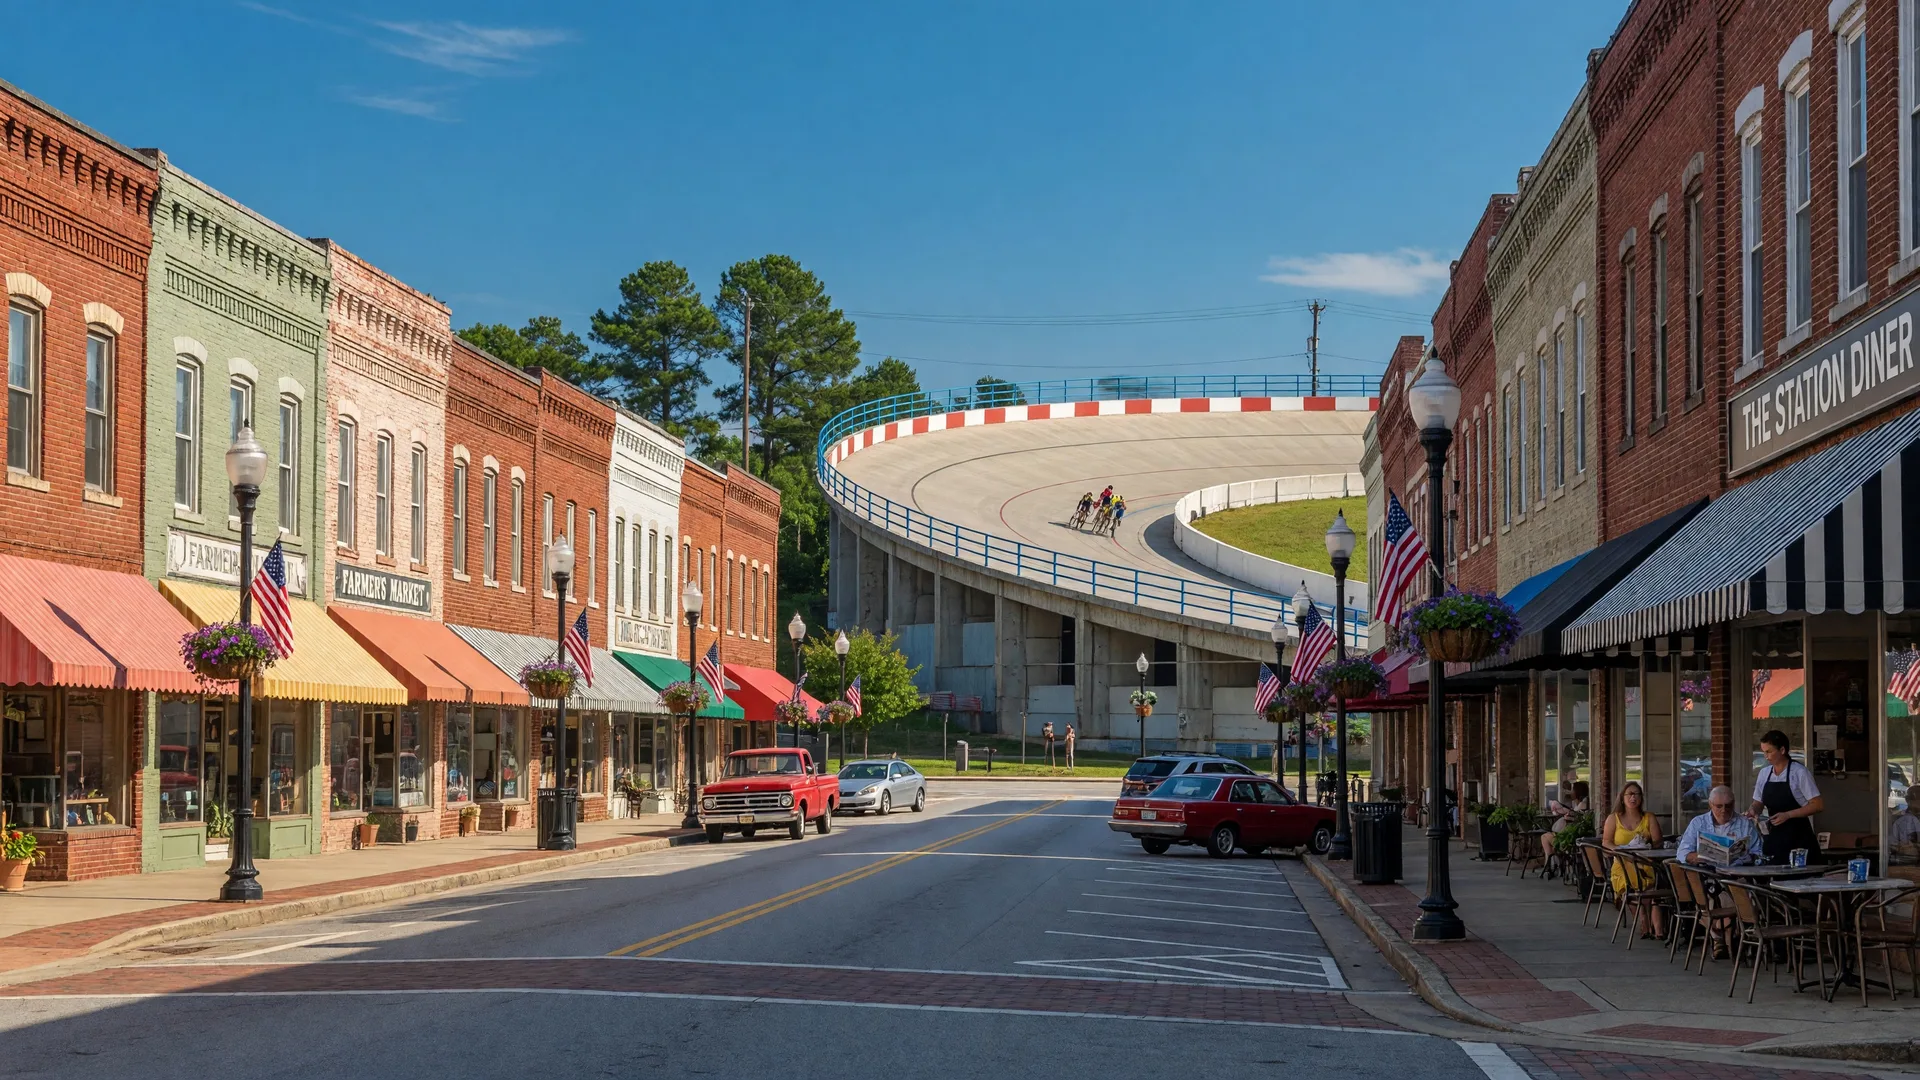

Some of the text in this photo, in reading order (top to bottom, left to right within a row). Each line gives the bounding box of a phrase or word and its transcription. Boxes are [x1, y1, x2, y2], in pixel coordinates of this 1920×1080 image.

[1743, 311, 1914, 451] THE STATION DINER
[342, 569, 426, 607] FARMER'S MARKET
